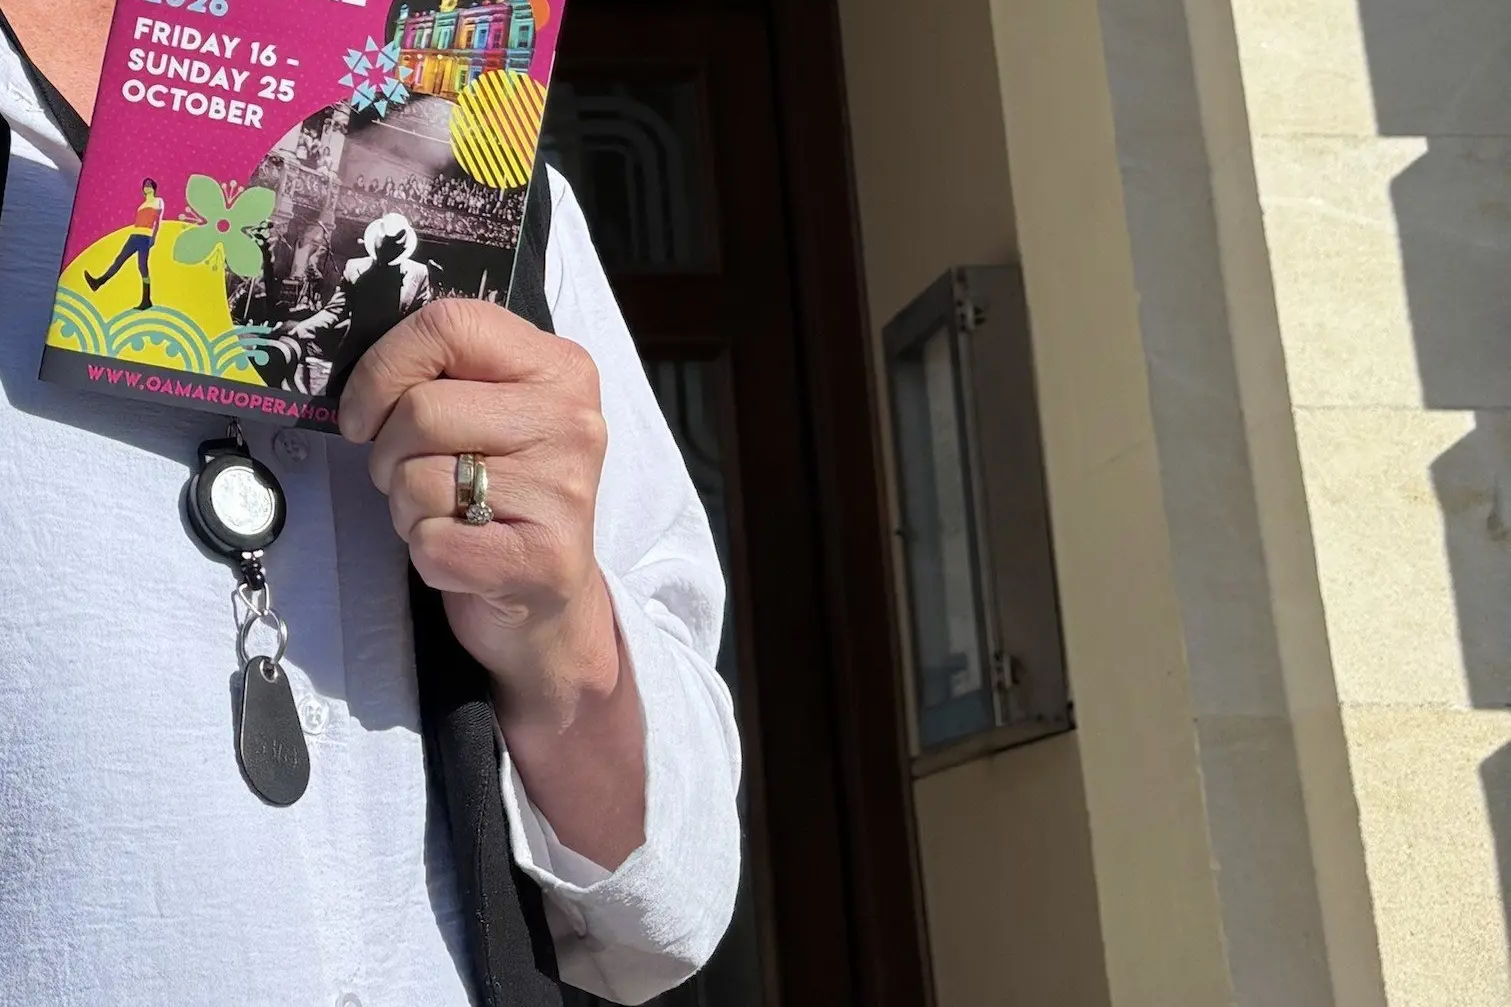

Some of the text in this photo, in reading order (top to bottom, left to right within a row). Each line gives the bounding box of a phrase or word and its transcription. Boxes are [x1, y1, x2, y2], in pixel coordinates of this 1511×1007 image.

[134, 16, 241, 59] FRIDAY
[250, 41, 277, 67] 16
[127, 47, 296, 103] SUNDAY 25
[121, 78, 264, 129] OCTOBER
